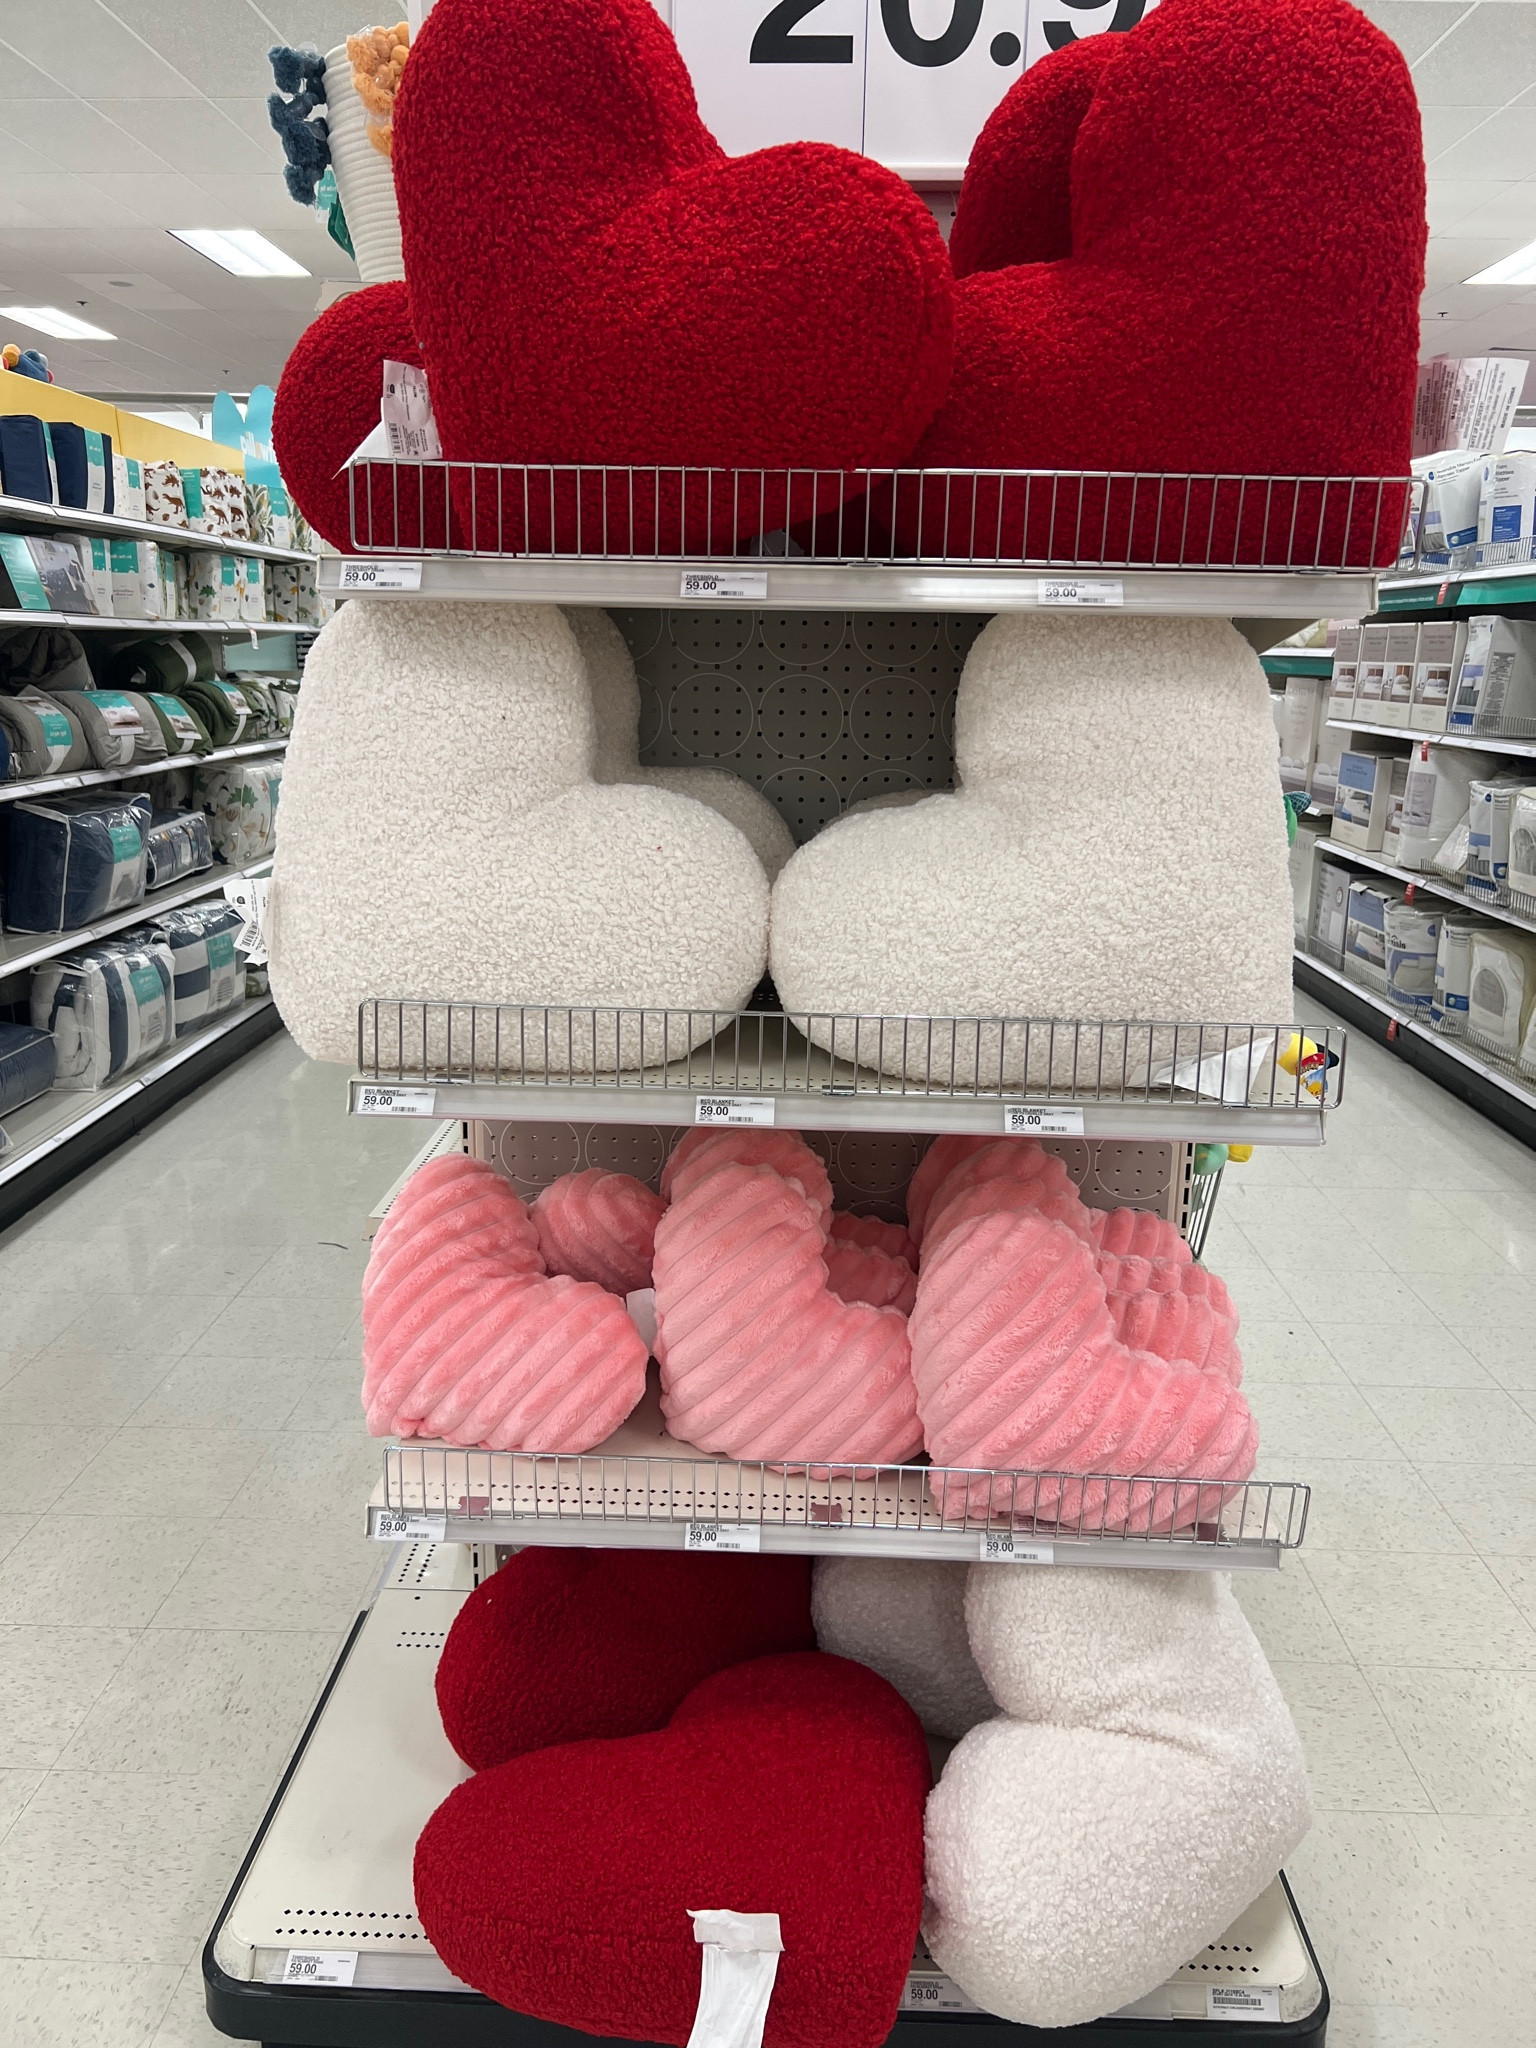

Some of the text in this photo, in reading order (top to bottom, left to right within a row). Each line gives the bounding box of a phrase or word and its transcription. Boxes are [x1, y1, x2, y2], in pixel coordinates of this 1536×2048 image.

[345, 572, 376, 581] 59.00
[686, 581, 716, 590] 59.00
[1046, 588, 1076, 597] 59.00
[364, 1096, 392, 1105] 59.00
[700, 1106, 728, 1115] 59.00
[1012, 1115, 1040, 1124] 59.00
[380, 1521, 406, 1531] 59.00
[690, 1531, 716, 1541] 59.00
[986, 1542, 1014, 1552] 59.00
[290, 1963, 317, 1974] 59.00
[911, 1988, 938, 2000] 59.00
